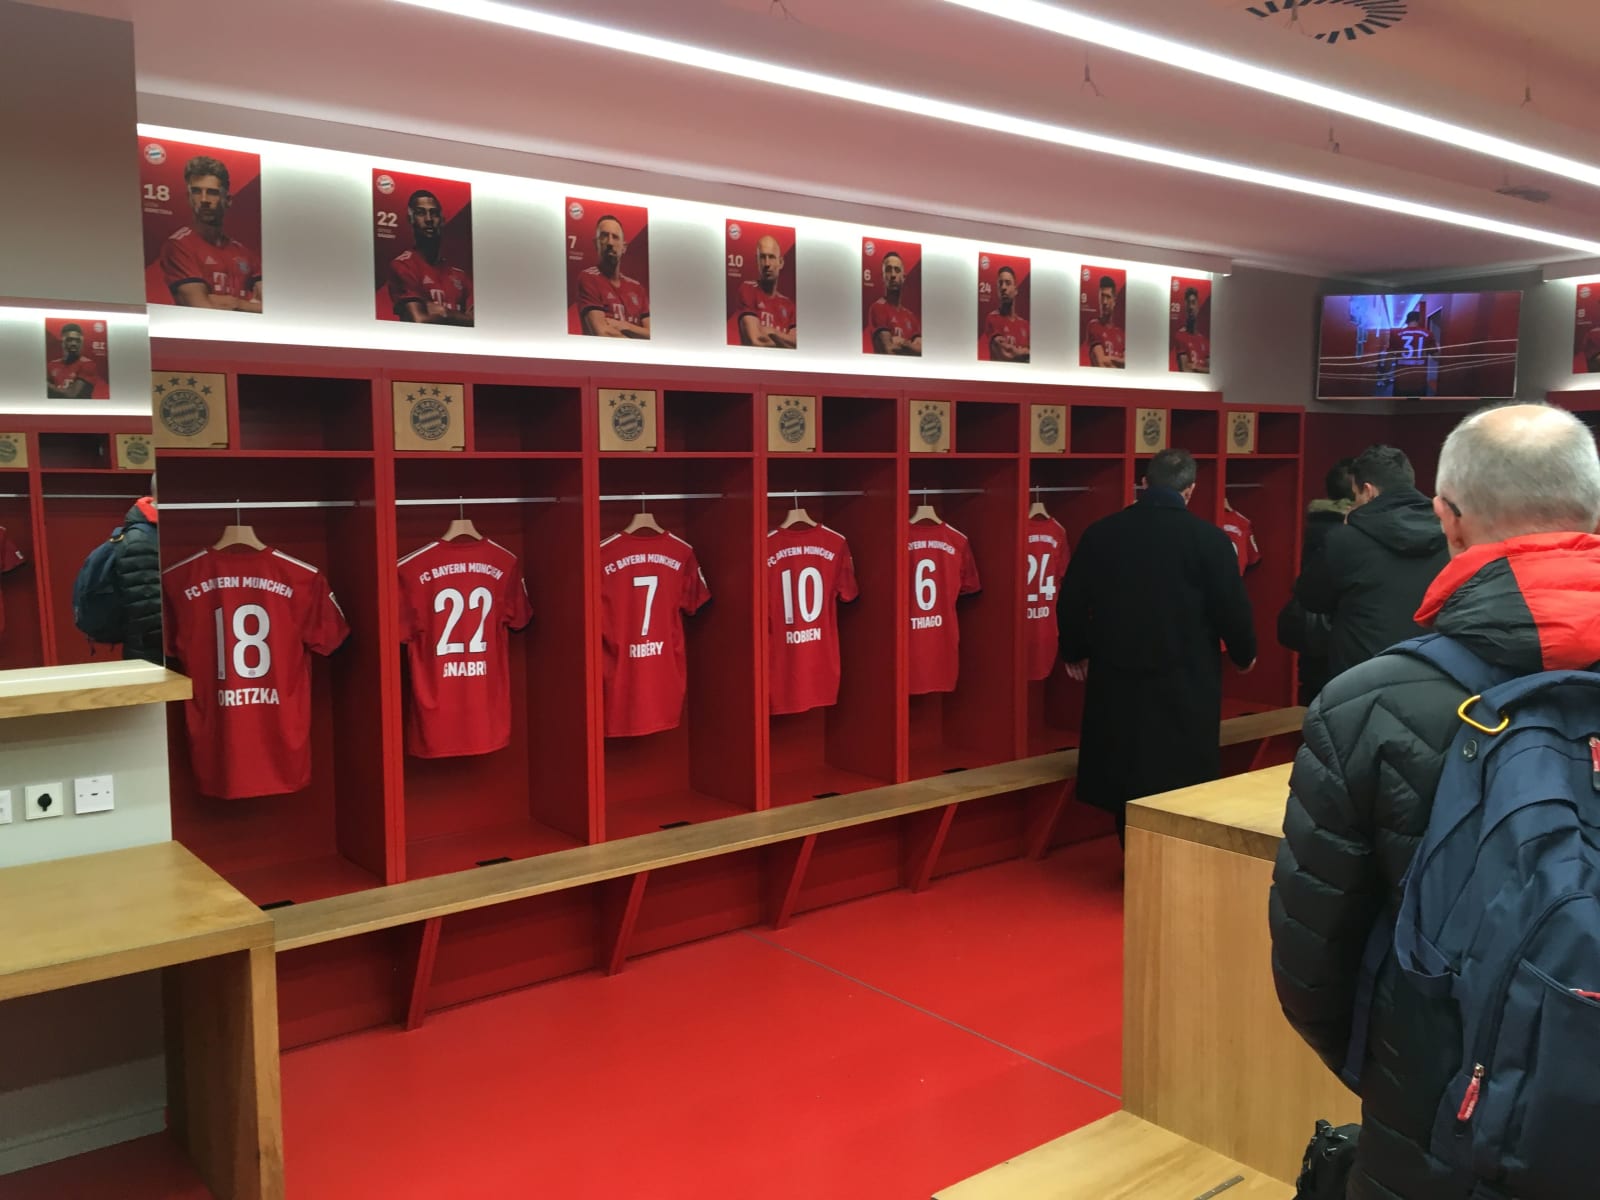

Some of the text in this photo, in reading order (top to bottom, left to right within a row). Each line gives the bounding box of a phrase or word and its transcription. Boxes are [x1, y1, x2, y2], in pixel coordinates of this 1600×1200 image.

[143, 183, 170, 201] 18
[377, 211, 398, 227] 22
[568, 235, 577, 249] 7
[728, 254, 744, 267] 10
[863, 269, 872, 281] 6
[979, 282, 991, 293] 24
[1401, 335, 1424, 358] 31
[419, 572, 431, 585] FC
[431, 563, 466, 579] BAYERN
[604, 563, 617, 575] FC
[616, 554, 646, 569] BAYERN
[915, 558, 937, 611] 6
[1027, 553, 1057, 602] 24
[184, 586, 201, 600] FC
[781, 566, 823, 624] 10
[633, 575, 658, 636] 7
[434, 586, 493, 656] 22
[910, 614, 943, 630] THIAGO
[215, 604, 271, 680] 18
[629, 639, 664, 658] RIBÉRY
